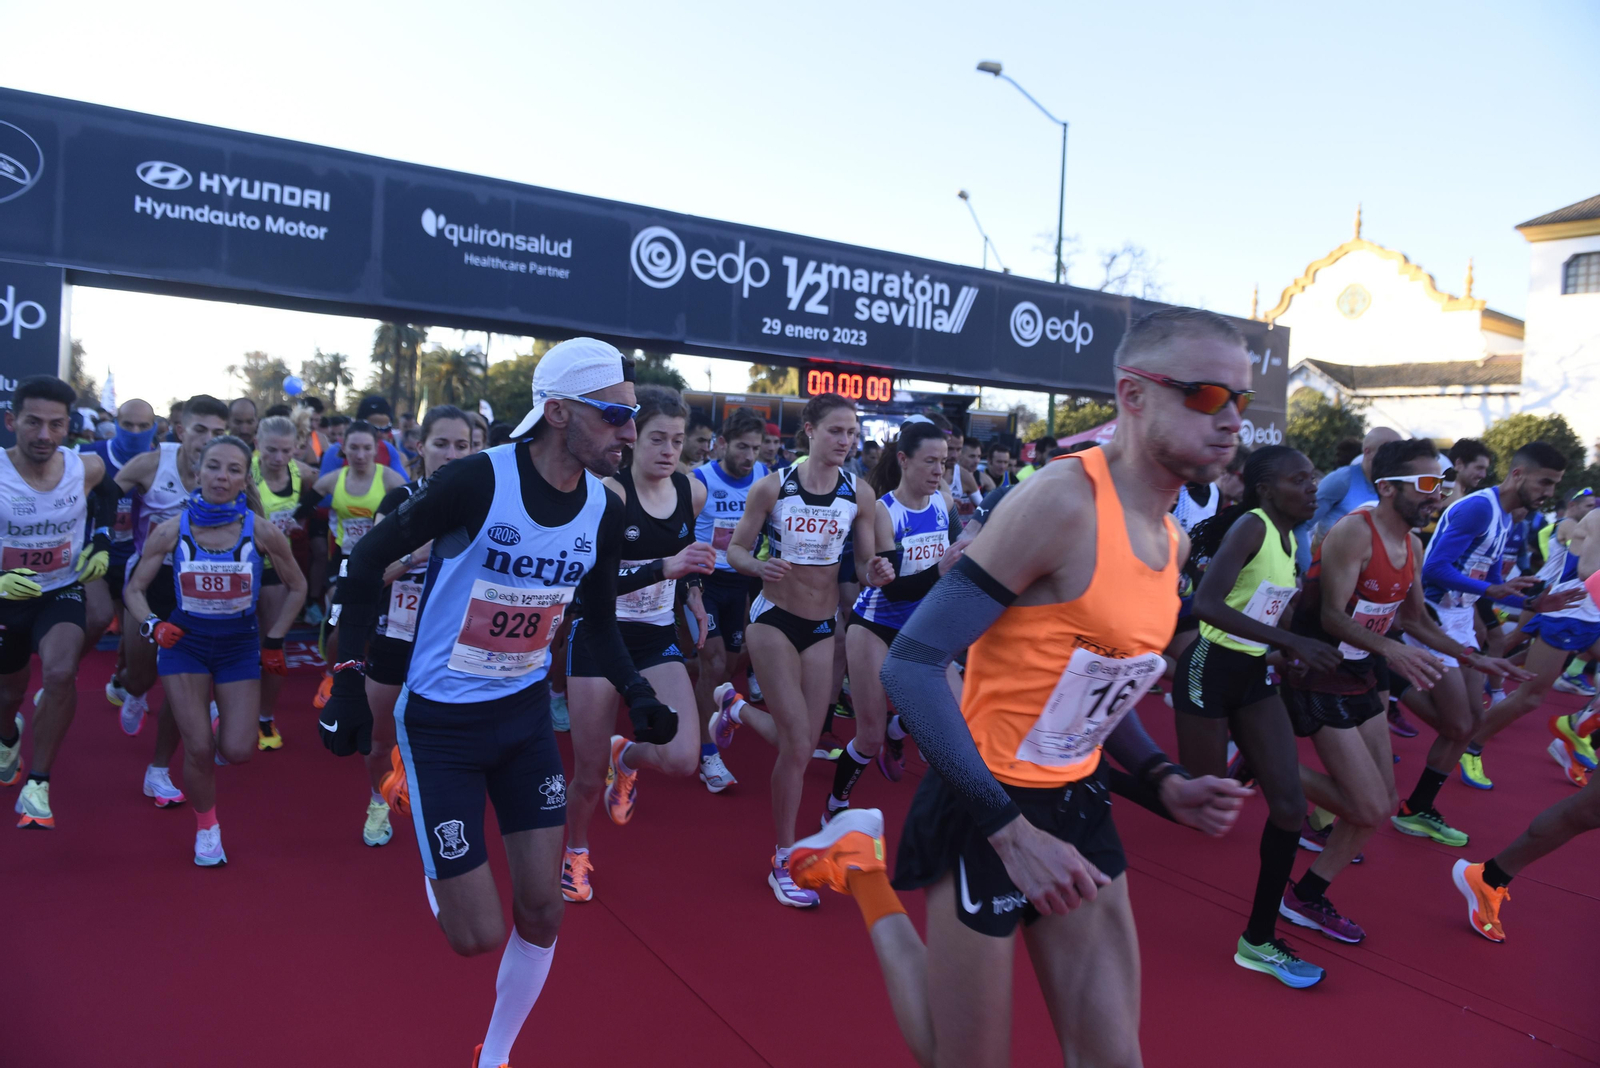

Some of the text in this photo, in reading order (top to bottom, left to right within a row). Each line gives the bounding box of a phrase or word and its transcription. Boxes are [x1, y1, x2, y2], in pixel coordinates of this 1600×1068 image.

[199, 171, 331, 212] HYUNDAI
[134, 195, 329, 241] Hyundauto Motor
[443, 223, 573, 259] quirónsalud
[464, 252, 571, 280] Healthcare Partner
[690, 239, 771, 299] edp
[822, 261, 951, 307] maratón
[854, 296, 952, 334] sevilla
[761, 317, 868, 347] 29 enero 2023
[1045, 309, 1094, 354] edp
[1254, 421, 1283, 446] edp
[7, 518, 77, 537] bathco
[487, 527, 520, 546] TROPS
[784, 515, 839, 536] 12673
[19, 550, 54, 566] 120
[482, 546, 585, 587] nerja
[906, 543, 945, 561] 12679
[202, 576, 224, 591] 88
[489, 610, 542, 638] 928
